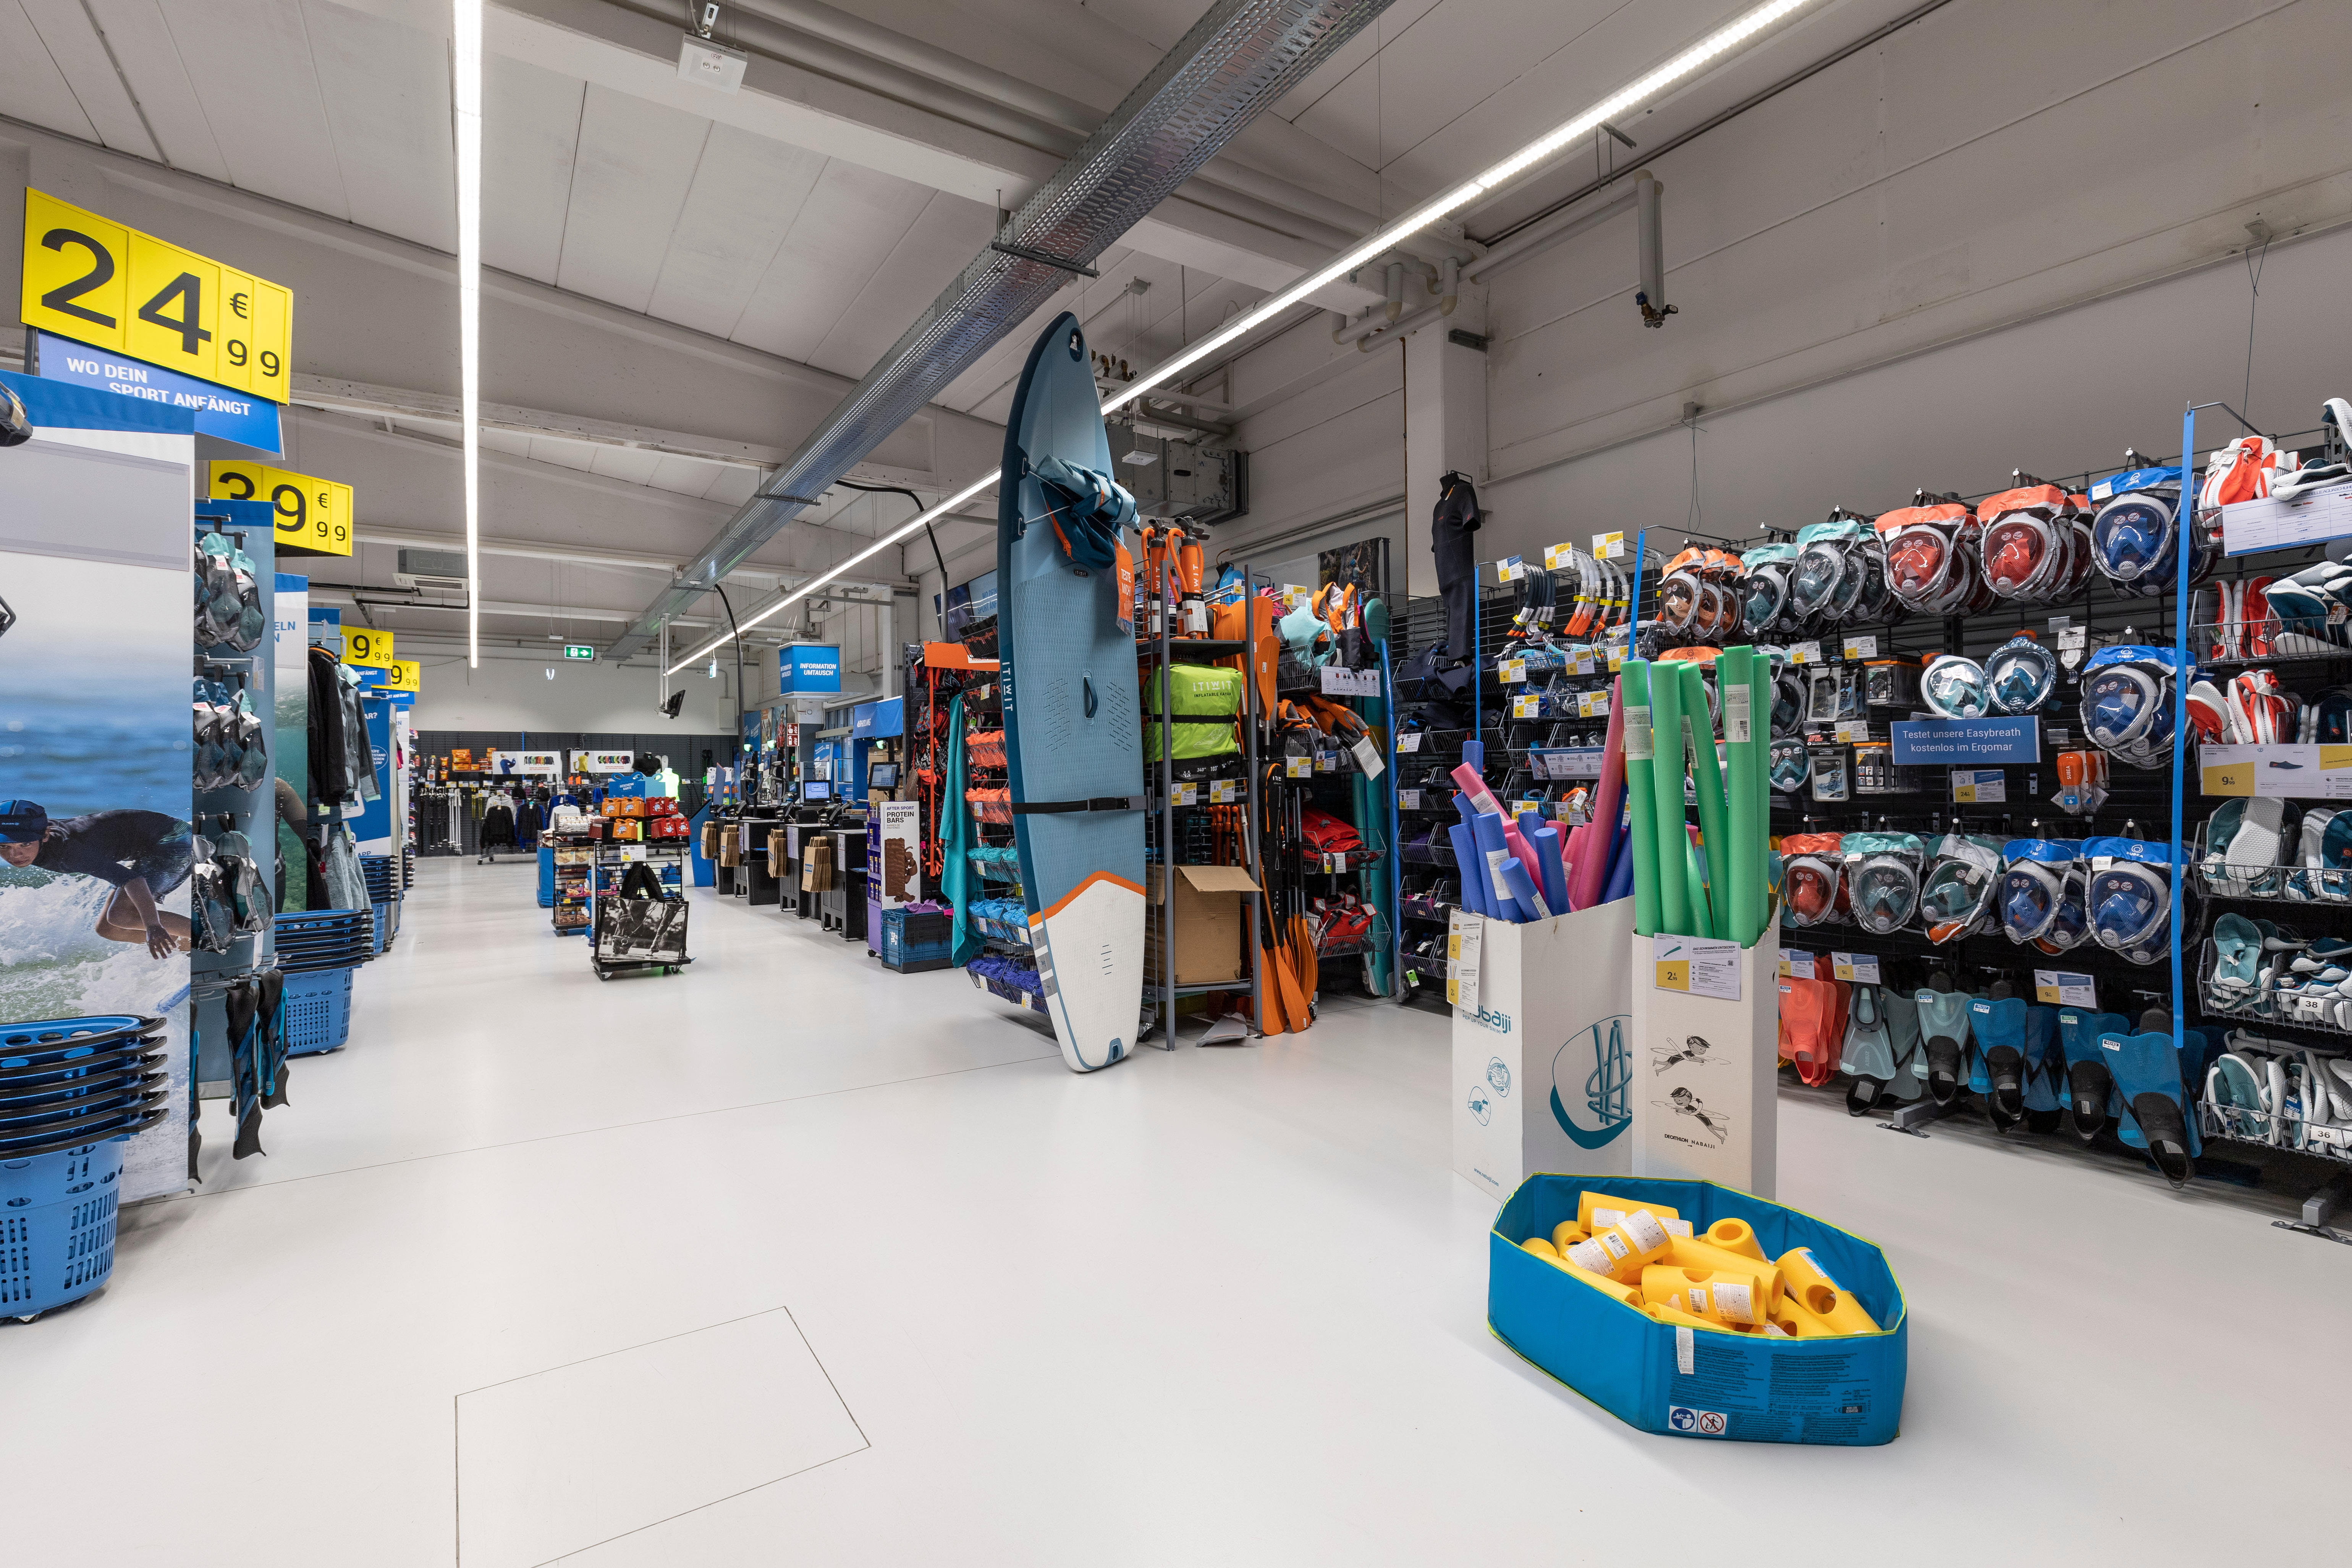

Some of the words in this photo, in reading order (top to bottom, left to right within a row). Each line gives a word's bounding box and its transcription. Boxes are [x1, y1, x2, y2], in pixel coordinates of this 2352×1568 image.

[41, 228, 211, 355] 24
[66, 357, 99, 375] WO
[105, 364, 147, 384] DEIN
[174, 393, 251, 416] ANFÄNGT
[1121, 568, 1131, 583] TESTE
[1002, 662, 1013, 711] ITIWIT
[1193, 681, 1231, 691] ITIWIT
[1967, 728, 2020, 739] Easybreath
[1911, 744, 1954, 752] kostenlos
[1972, 743, 2012, 753] Ergomar
[1668, 972, 1673, 980] 2
[1462, 1005, 1511, 1034] abaiji
[1490, 1026, 1501, 1035] SWIM!
[1665, 1134, 1688, 1143] DECATHLON
[1691, 1140, 1715, 1149] NABAIJI
[1474, 1167, 1499, 1187] www.nabaiji.com
